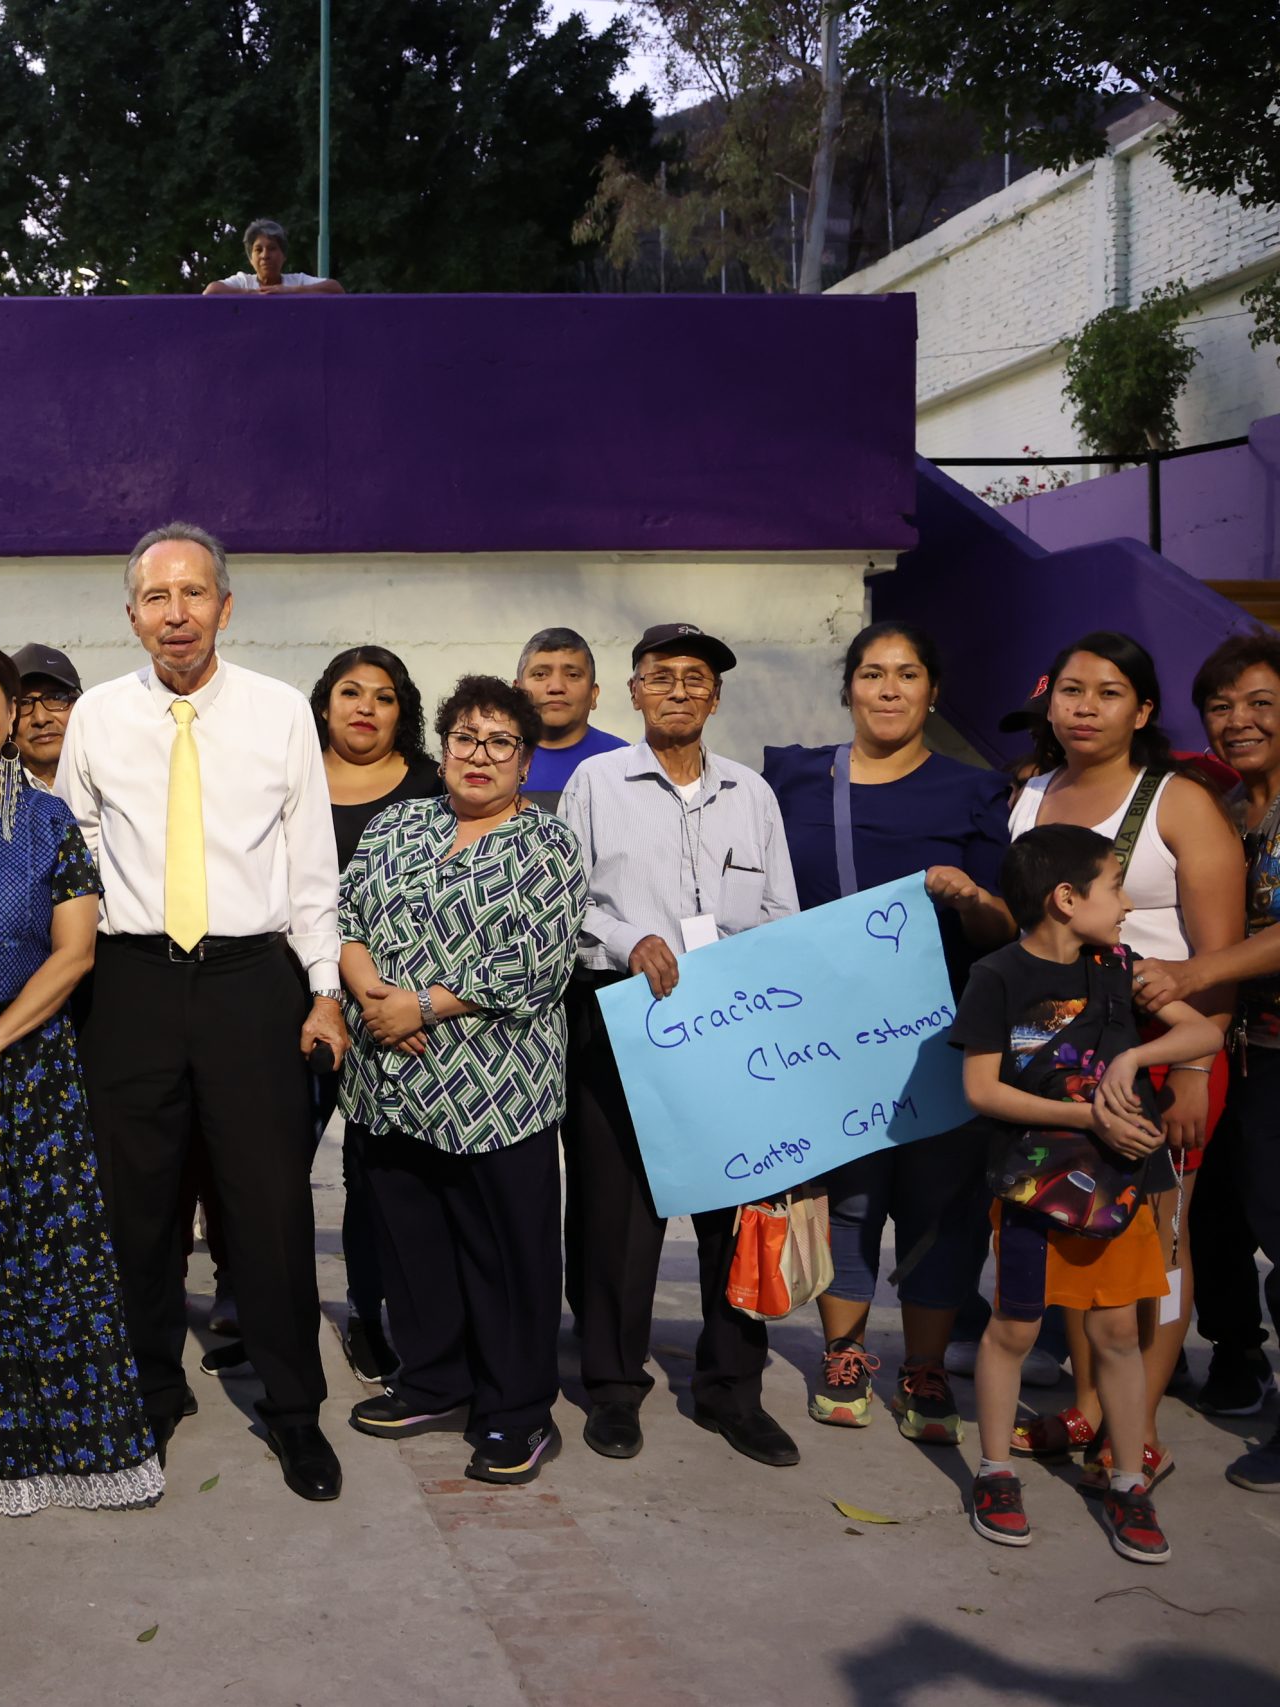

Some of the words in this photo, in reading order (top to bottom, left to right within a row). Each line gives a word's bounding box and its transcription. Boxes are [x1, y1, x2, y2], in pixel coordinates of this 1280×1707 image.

[1129, 773, 1161, 817] BIMB
[646, 987, 802, 1049] Gracias
[747, 1042, 840, 1081] Clara
[856, 1004, 955, 1046] estamos
[724, 1137, 811, 1180] Contigo
[842, 1096, 918, 1137] GAM
